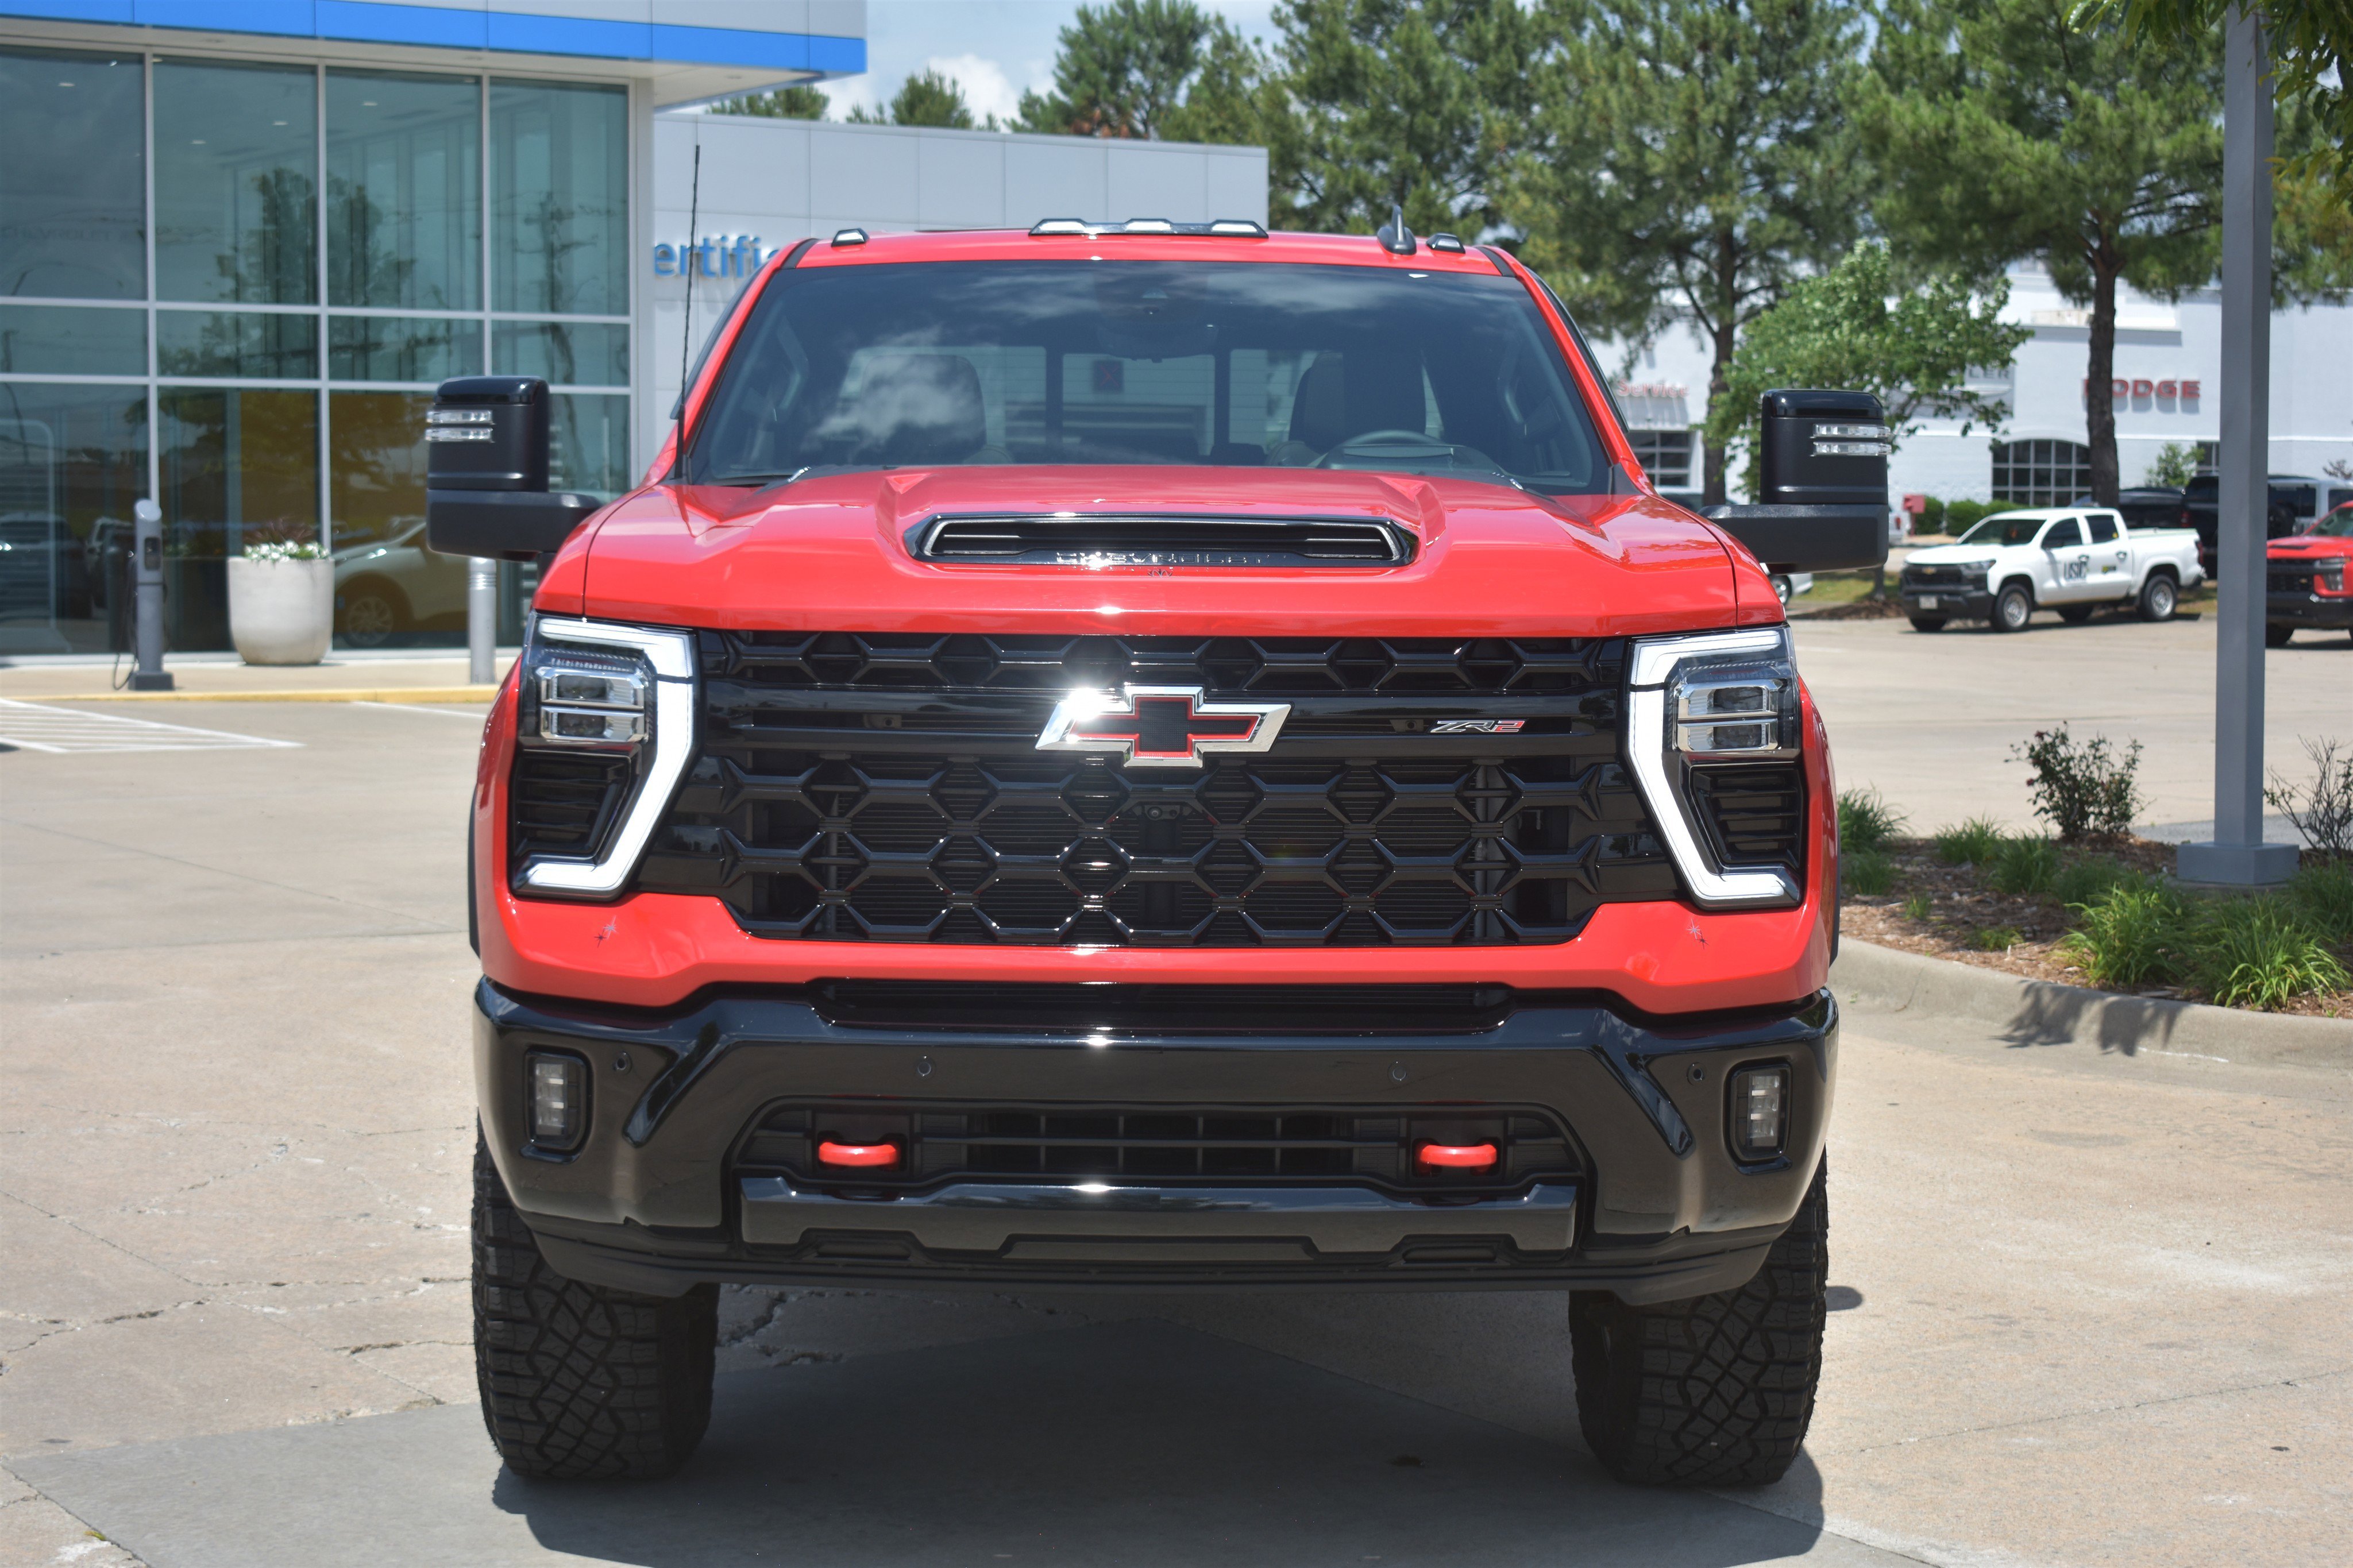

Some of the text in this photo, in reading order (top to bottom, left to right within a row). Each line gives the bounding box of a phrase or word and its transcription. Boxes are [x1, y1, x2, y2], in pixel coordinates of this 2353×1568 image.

[654, 235, 780, 278] ertifi
[1617, 379, 1689, 397] Service
[2083, 379, 2200, 399] ODGE
[1430, 720, 1526, 733] ZR2
